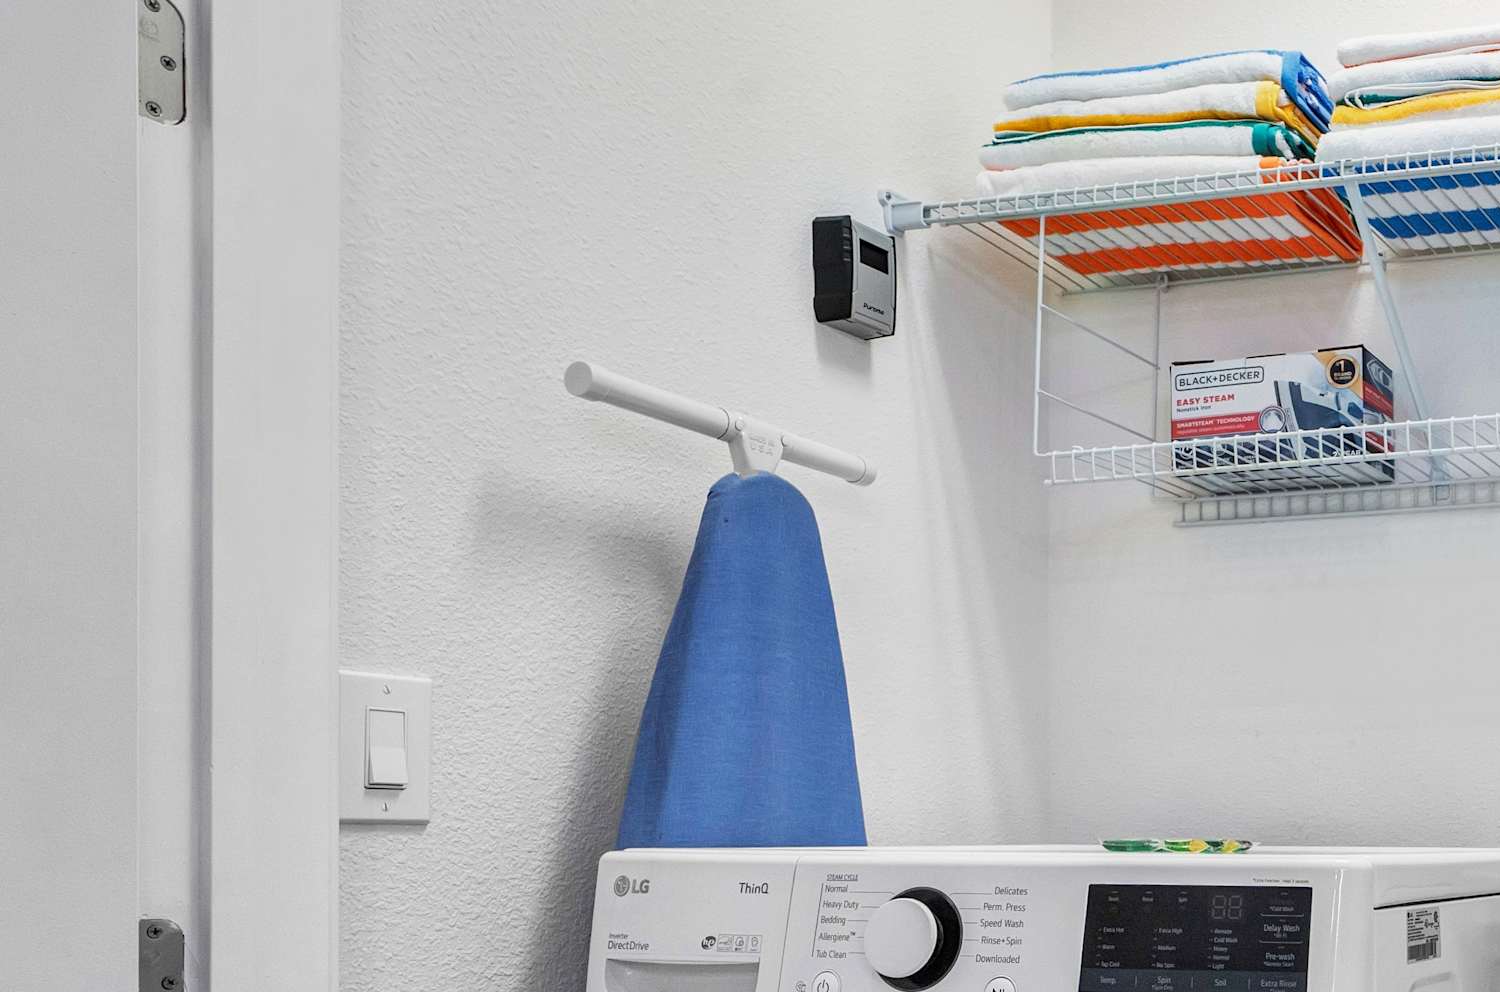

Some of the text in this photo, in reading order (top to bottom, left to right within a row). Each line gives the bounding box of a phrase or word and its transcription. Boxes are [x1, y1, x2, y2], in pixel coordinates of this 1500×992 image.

[1179, 370, 1260, 387] BLACK+DECKER
[1176, 393, 1235, 407] EASY STEAM
[1216, 415, 1256, 425] TECHNOLOGY
[631, 879, 650, 894] LG
[739, 882, 769, 894] ThinQ
[825, 884, 849, 893] Normal
[994, 886, 1028, 896] Delicates
[822, 900, 859, 910] Heavy Duty
[1005, 903, 1026, 912] Press
[820, 915, 846, 926] Bedding
[980, 918, 1024, 928] Speed Wash
[1282, 924, 1300, 933] Wash
[816, 949, 847, 959] Tub Clean
[975, 953, 1021, 964] Downloaded
